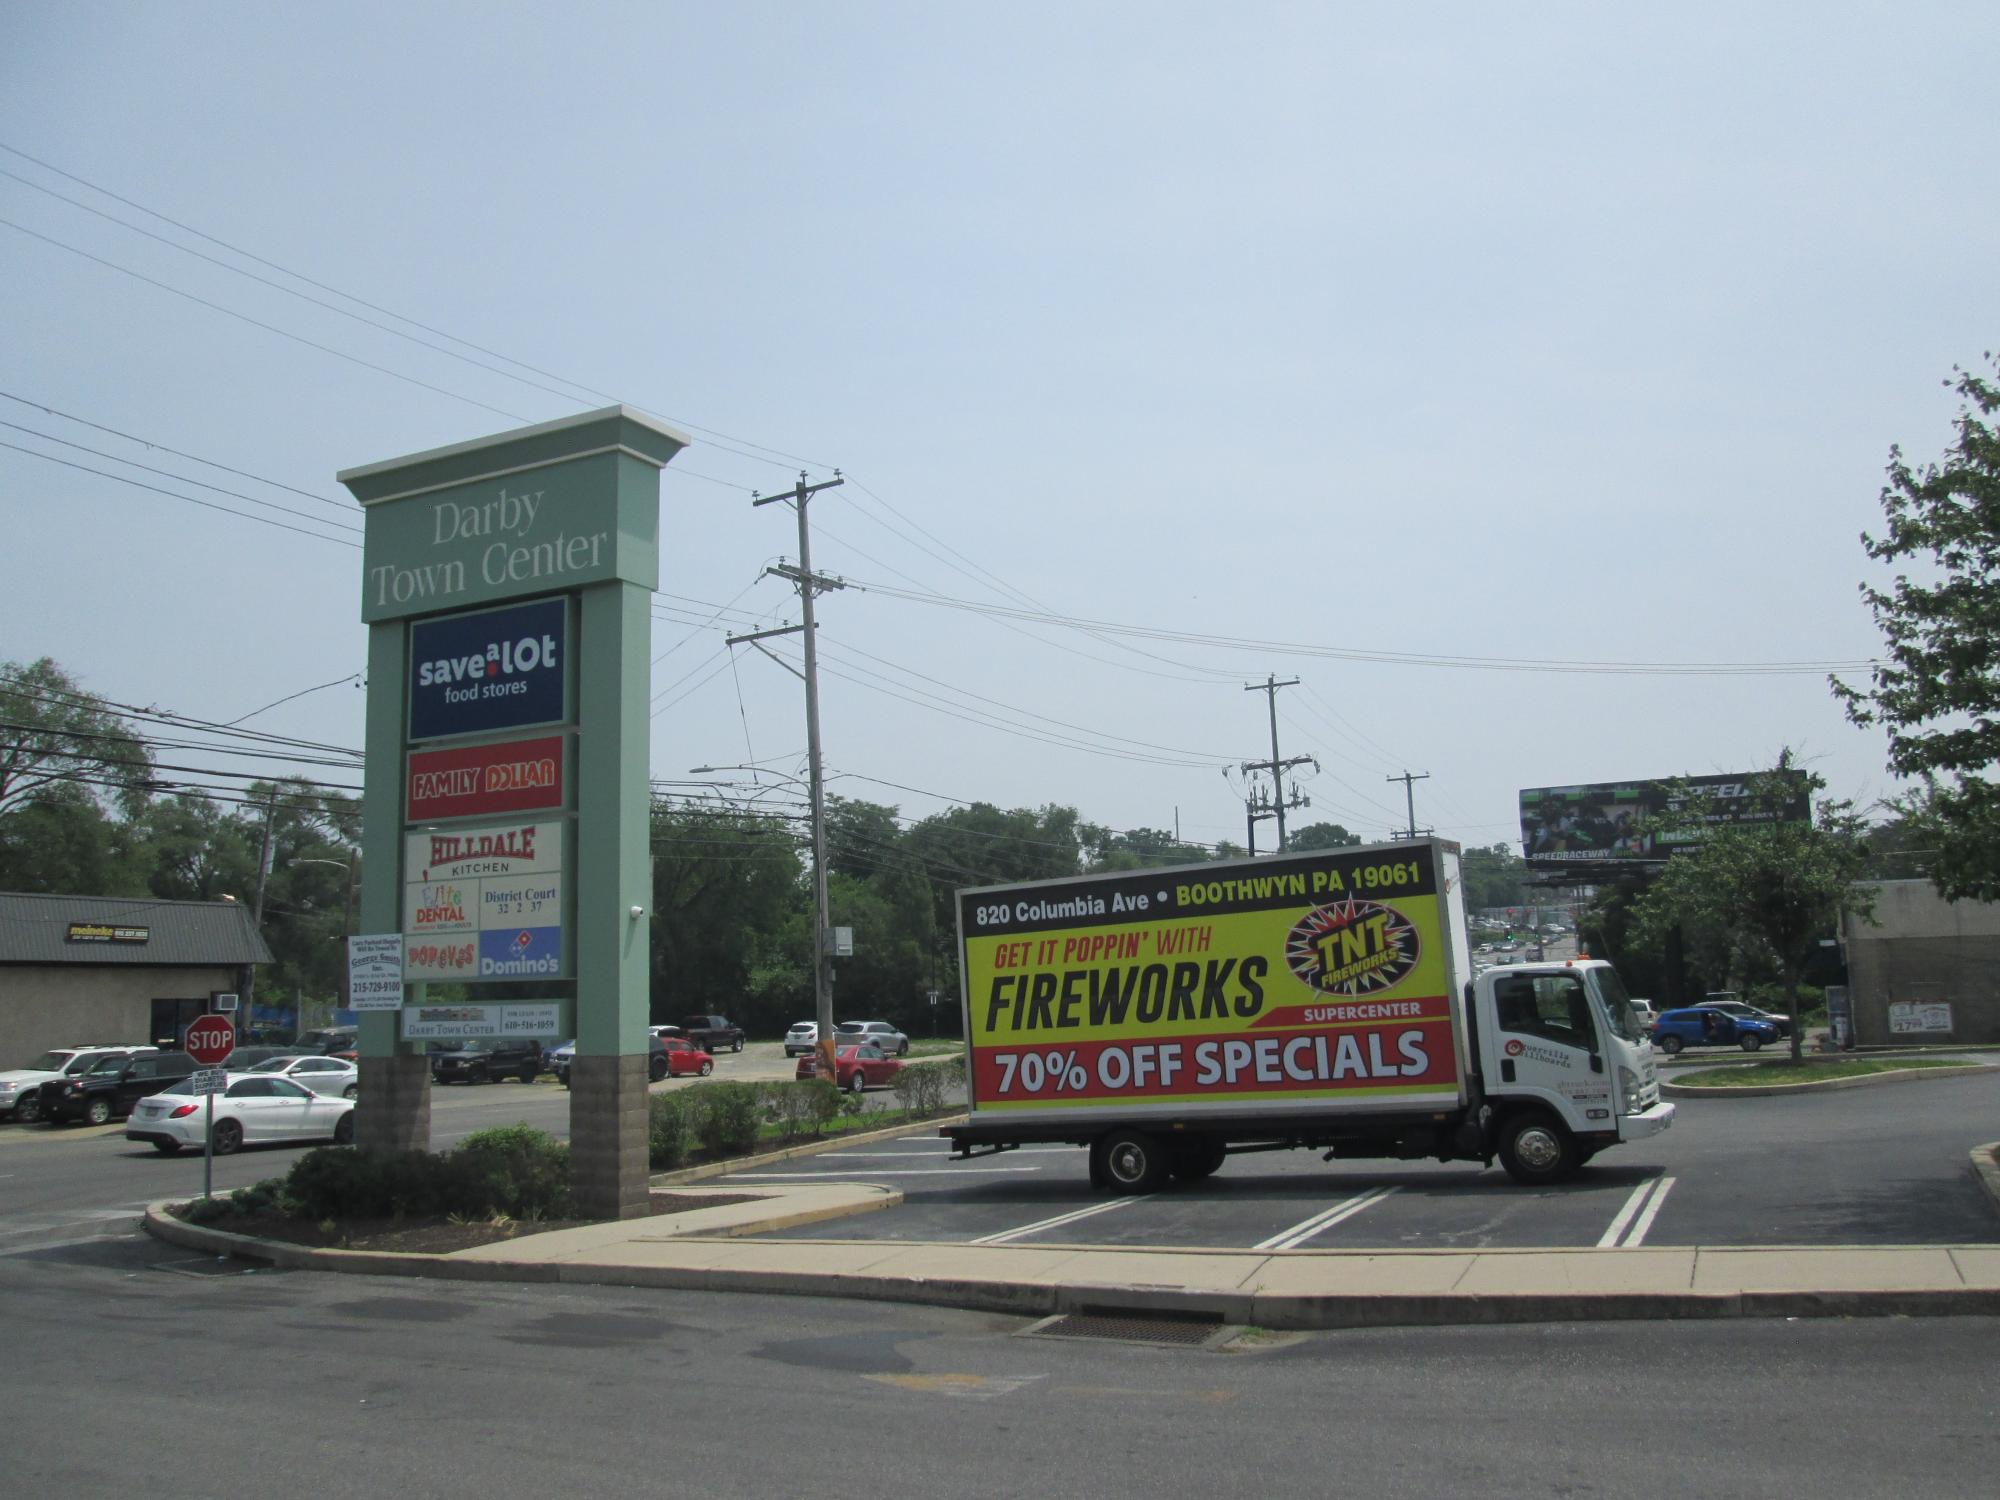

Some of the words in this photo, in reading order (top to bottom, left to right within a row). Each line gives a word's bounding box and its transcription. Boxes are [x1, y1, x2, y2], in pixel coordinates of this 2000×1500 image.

[432, 488, 545, 545] Darby
[371, 560, 466, 606] Town
[481, 531, 608, 585] Center
[445, 683, 479, 704] food
[482, 680, 528, 698] stores
[413, 767, 481, 800] FAMILY
[485, 758, 555, 793] DOLLAR
[430, 825, 536, 868] HILLDALE
[452, 863, 510, 876] KITCHEN
[485, 890, 522, 903] District
[525, 887, 556, 900] Court
[497, 903, 509, 914] 32
[516, 902, 522, 913] 2
[530, 901, 542, 913] 37
[976, 904, 1010, 926] 820
[1015, 896, 1106, 922] Columbia
[1111, 892, 1149, 913] Ave
[1176, 872, 1306, 906] BOOTHWYN
[1312, 870, 1344, 893] PA
[1352, 861, 1420, 889] 19061
[416, 906, 465, 923] DENTAL
[995, 941, 1032, 969] GET
[1038, 940, 1058, 965] IT
[1063, 931, 1149, 963] POPPIN'
[1157, 925, 1212, 956] WITH
[1317, 912, 1389, 972] TNT
[481, 953, 559, 975] Domino's
[1321, 947, 1399, 988] FIREWORKS
[352, 981, 400, 993] 215-729-9100
[985, 955, 1269, 1033] FIREWORKS
[1304, 1002, 1422, 1022] SUPERCENTER
[188, 1030, 232, 1050] STOP
[436, 1024, 461, 1034] TOWN
[463, 1024, 495, 1034] CENTER
[994, 1050, 1088, 1094] 70%
[1097, 1043, 1183, 1089] OFF
[1195, 1030, 1430, 1087] SPECIALS
